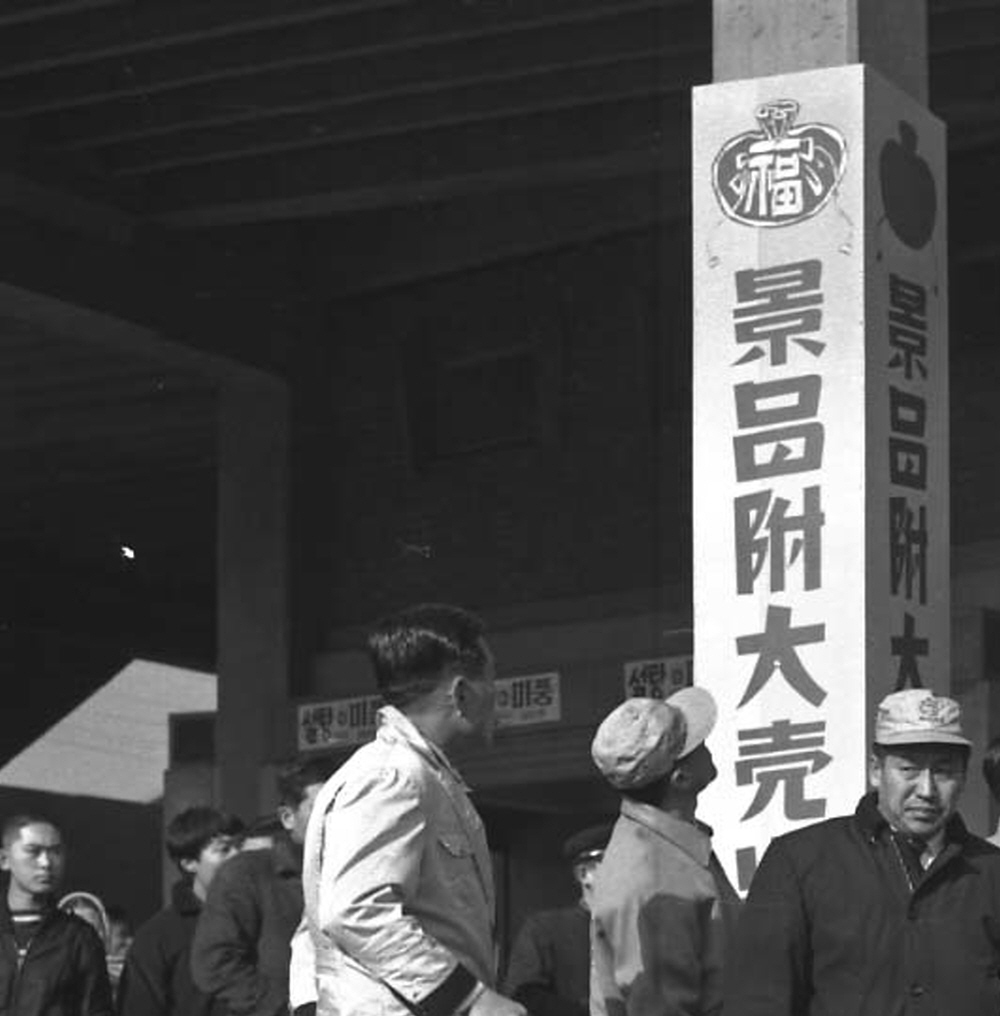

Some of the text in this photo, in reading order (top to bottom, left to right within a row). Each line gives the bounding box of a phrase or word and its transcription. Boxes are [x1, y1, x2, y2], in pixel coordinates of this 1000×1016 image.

[744, 137, 803, 216] 福
[731, 258, 833, 891] 景品附大売
[512, 677, 553, 708] 미풍
